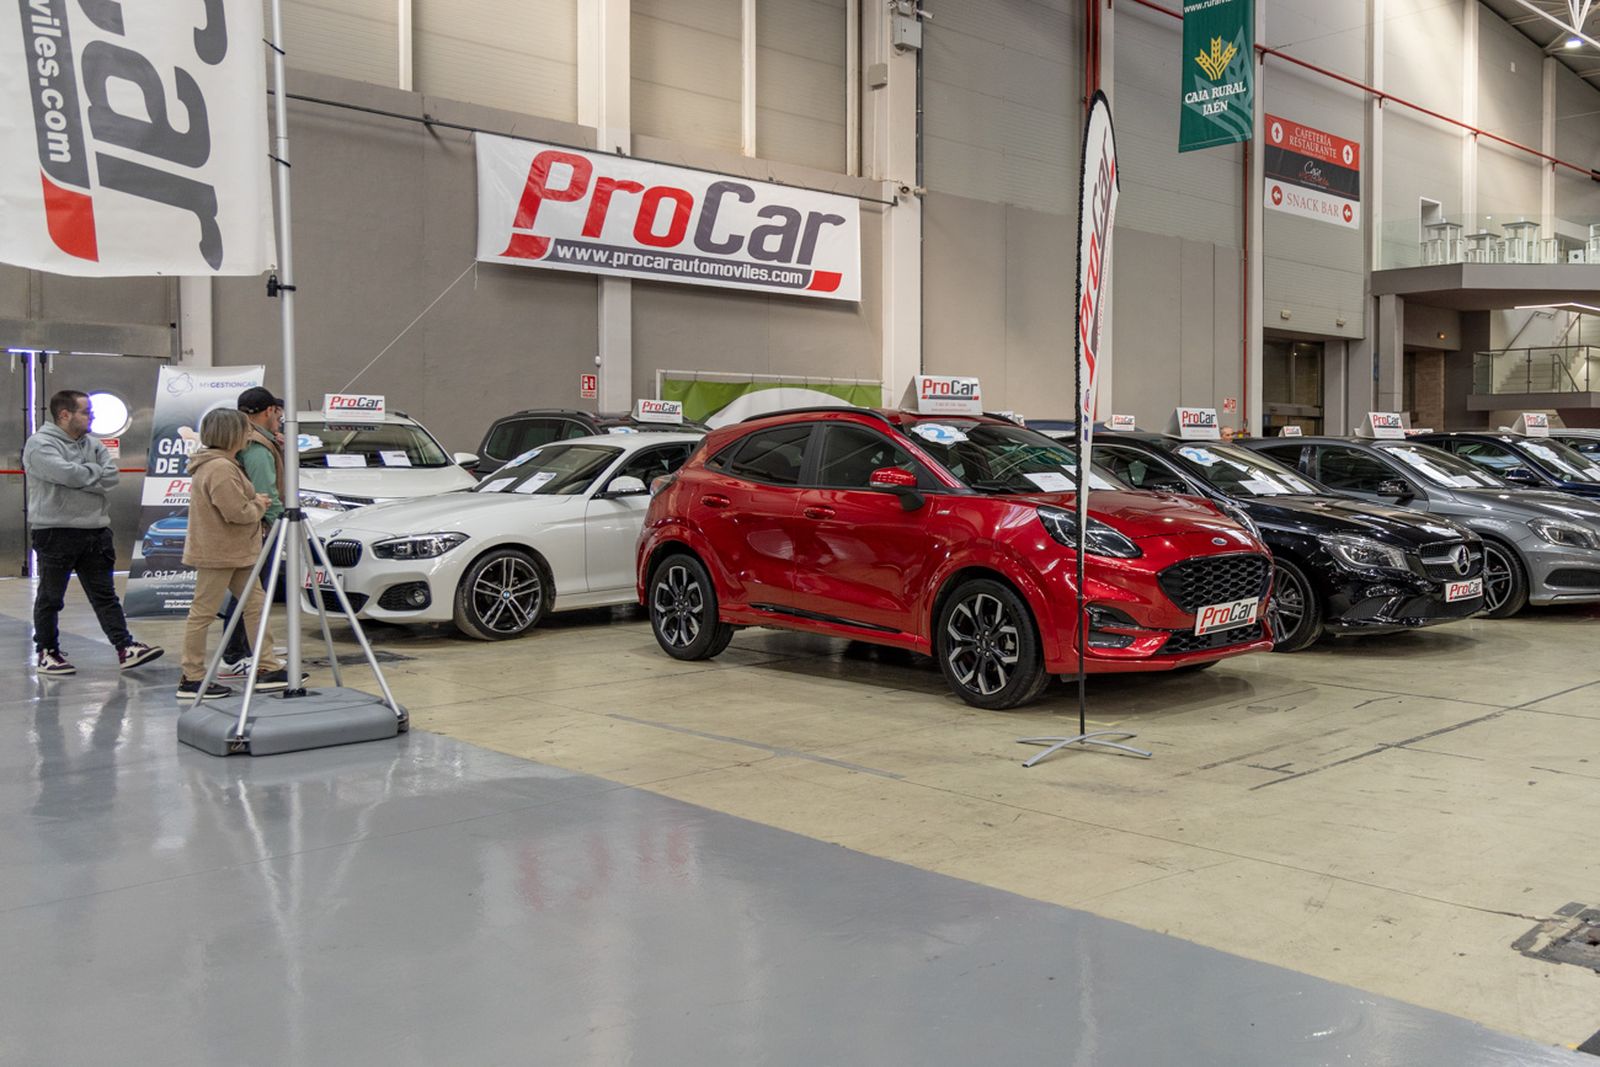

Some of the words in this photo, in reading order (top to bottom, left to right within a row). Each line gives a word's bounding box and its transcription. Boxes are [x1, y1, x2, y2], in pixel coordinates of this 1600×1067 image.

[1212, 81, 1247, 98] RURAL
[1203, 99, 1228, 116] JAÉN
[1295, 127, 1332, 147] CAFETERÍA
[1289, 135, 1337, 158] RESTAURANTE
[512, 150, 846, 266] ProCar
[1287, 193, 1320, 213] SNACK
[1321, 201, 1339, 217] BAR
[556, 243, 803, 286] www.procarautomoviles.com
[922, 378, 978, 395] ProCar
[330, 396, 382, 408] ProCar
[642, 401, 681, 412] ProCar
[1182, 411, 1216, 424] ProCar
[1372, 414, 1400, 426] ProCar
[155, 458, 180, 474] DE
[154, 570, 177, 580] 917
[1450, 582, 1481, 596] ProCar
[1200, 602, 1256, 627] ProCar
